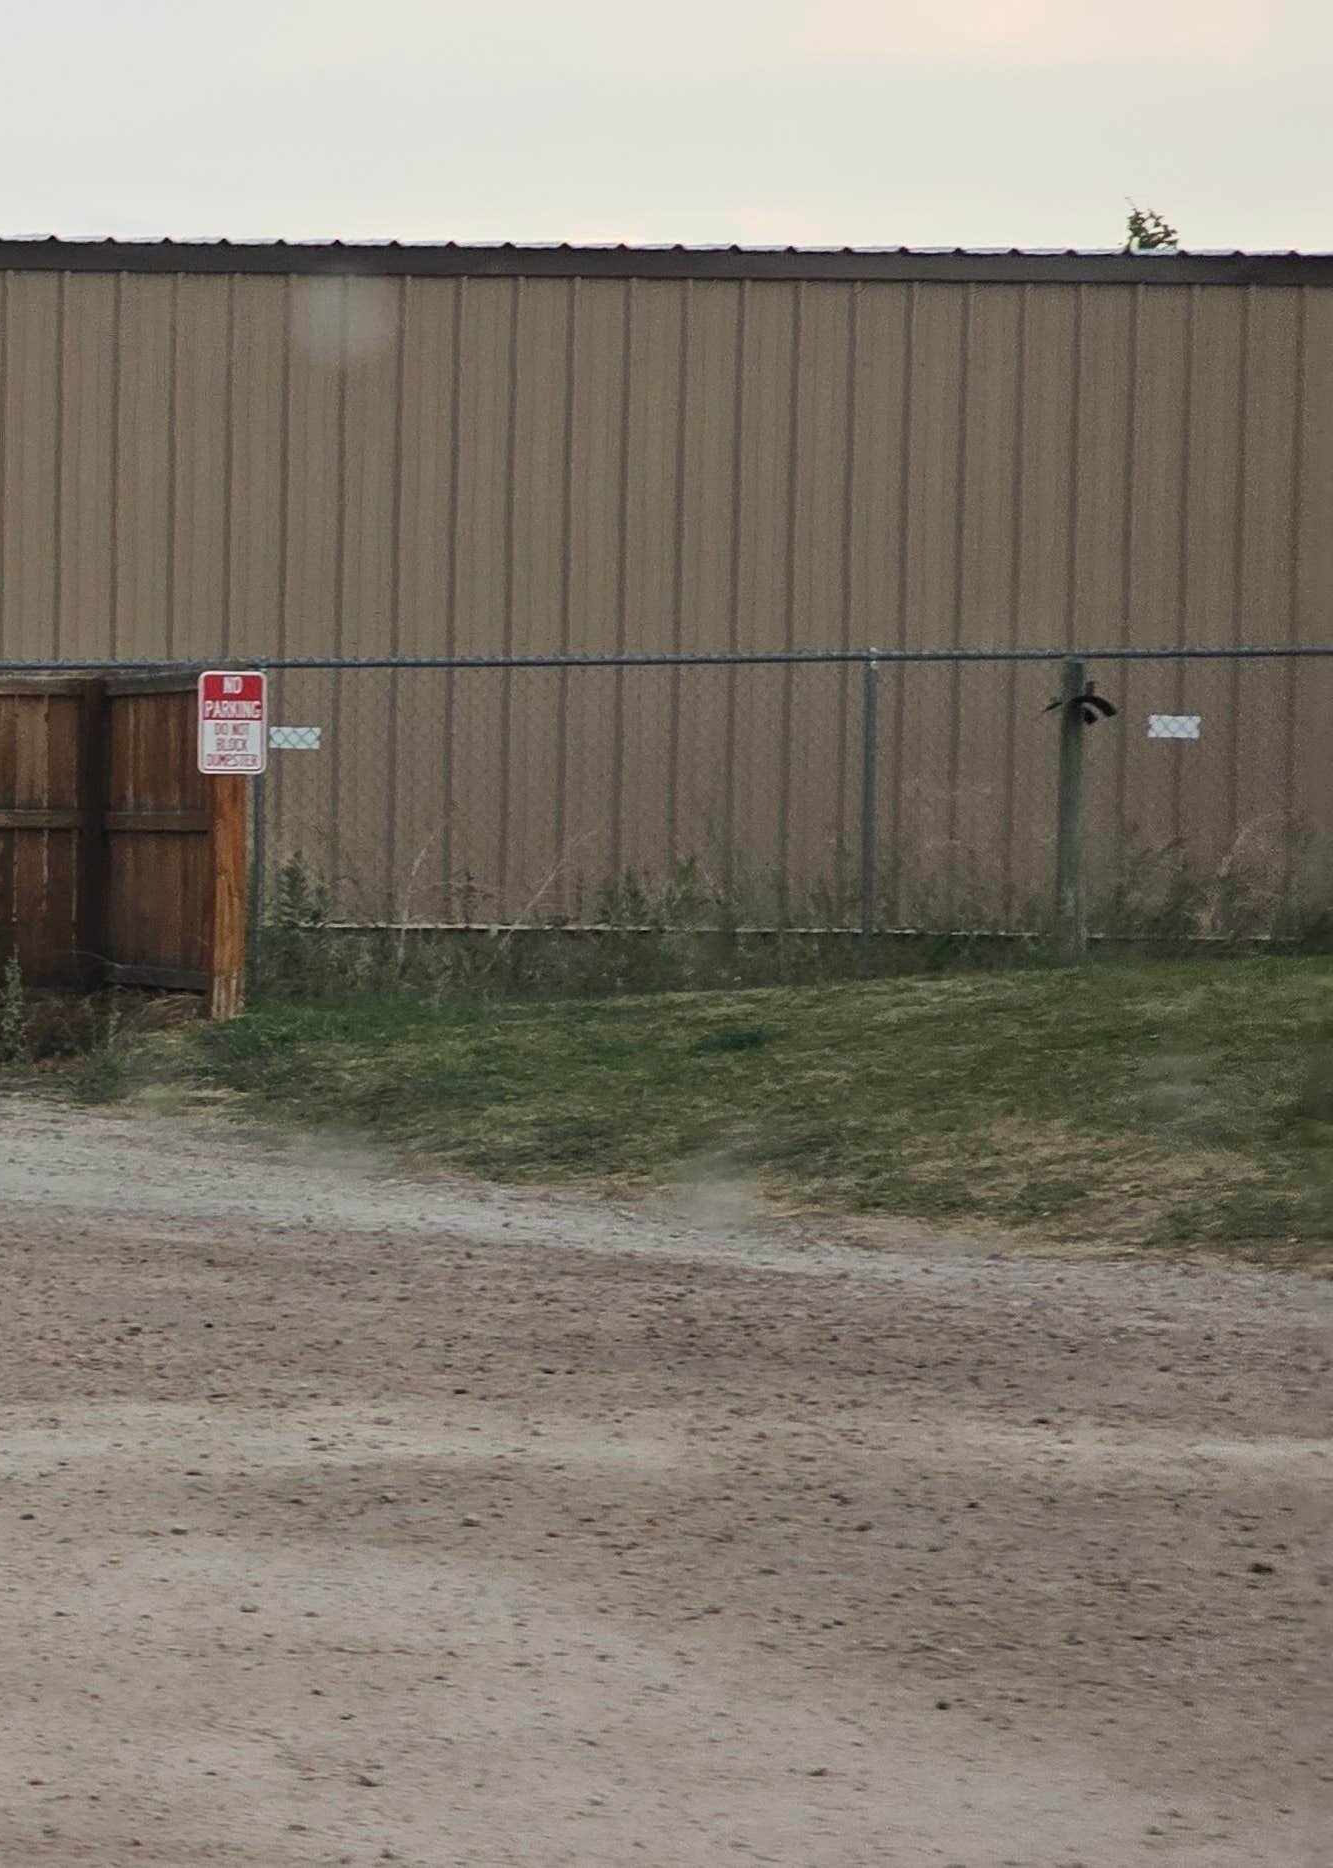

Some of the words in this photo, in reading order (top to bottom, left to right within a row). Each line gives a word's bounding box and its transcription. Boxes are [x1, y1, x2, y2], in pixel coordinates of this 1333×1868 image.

[223, 676, 243, 694] NO
[204, 700, 262, 718] PARKING
[214, 723, 228, 735] DO
[232, 723, 249, 735] NOT
[216, 738, 248, 752] BLOCK
[206, 754, 259, 767] DUMPSTER
